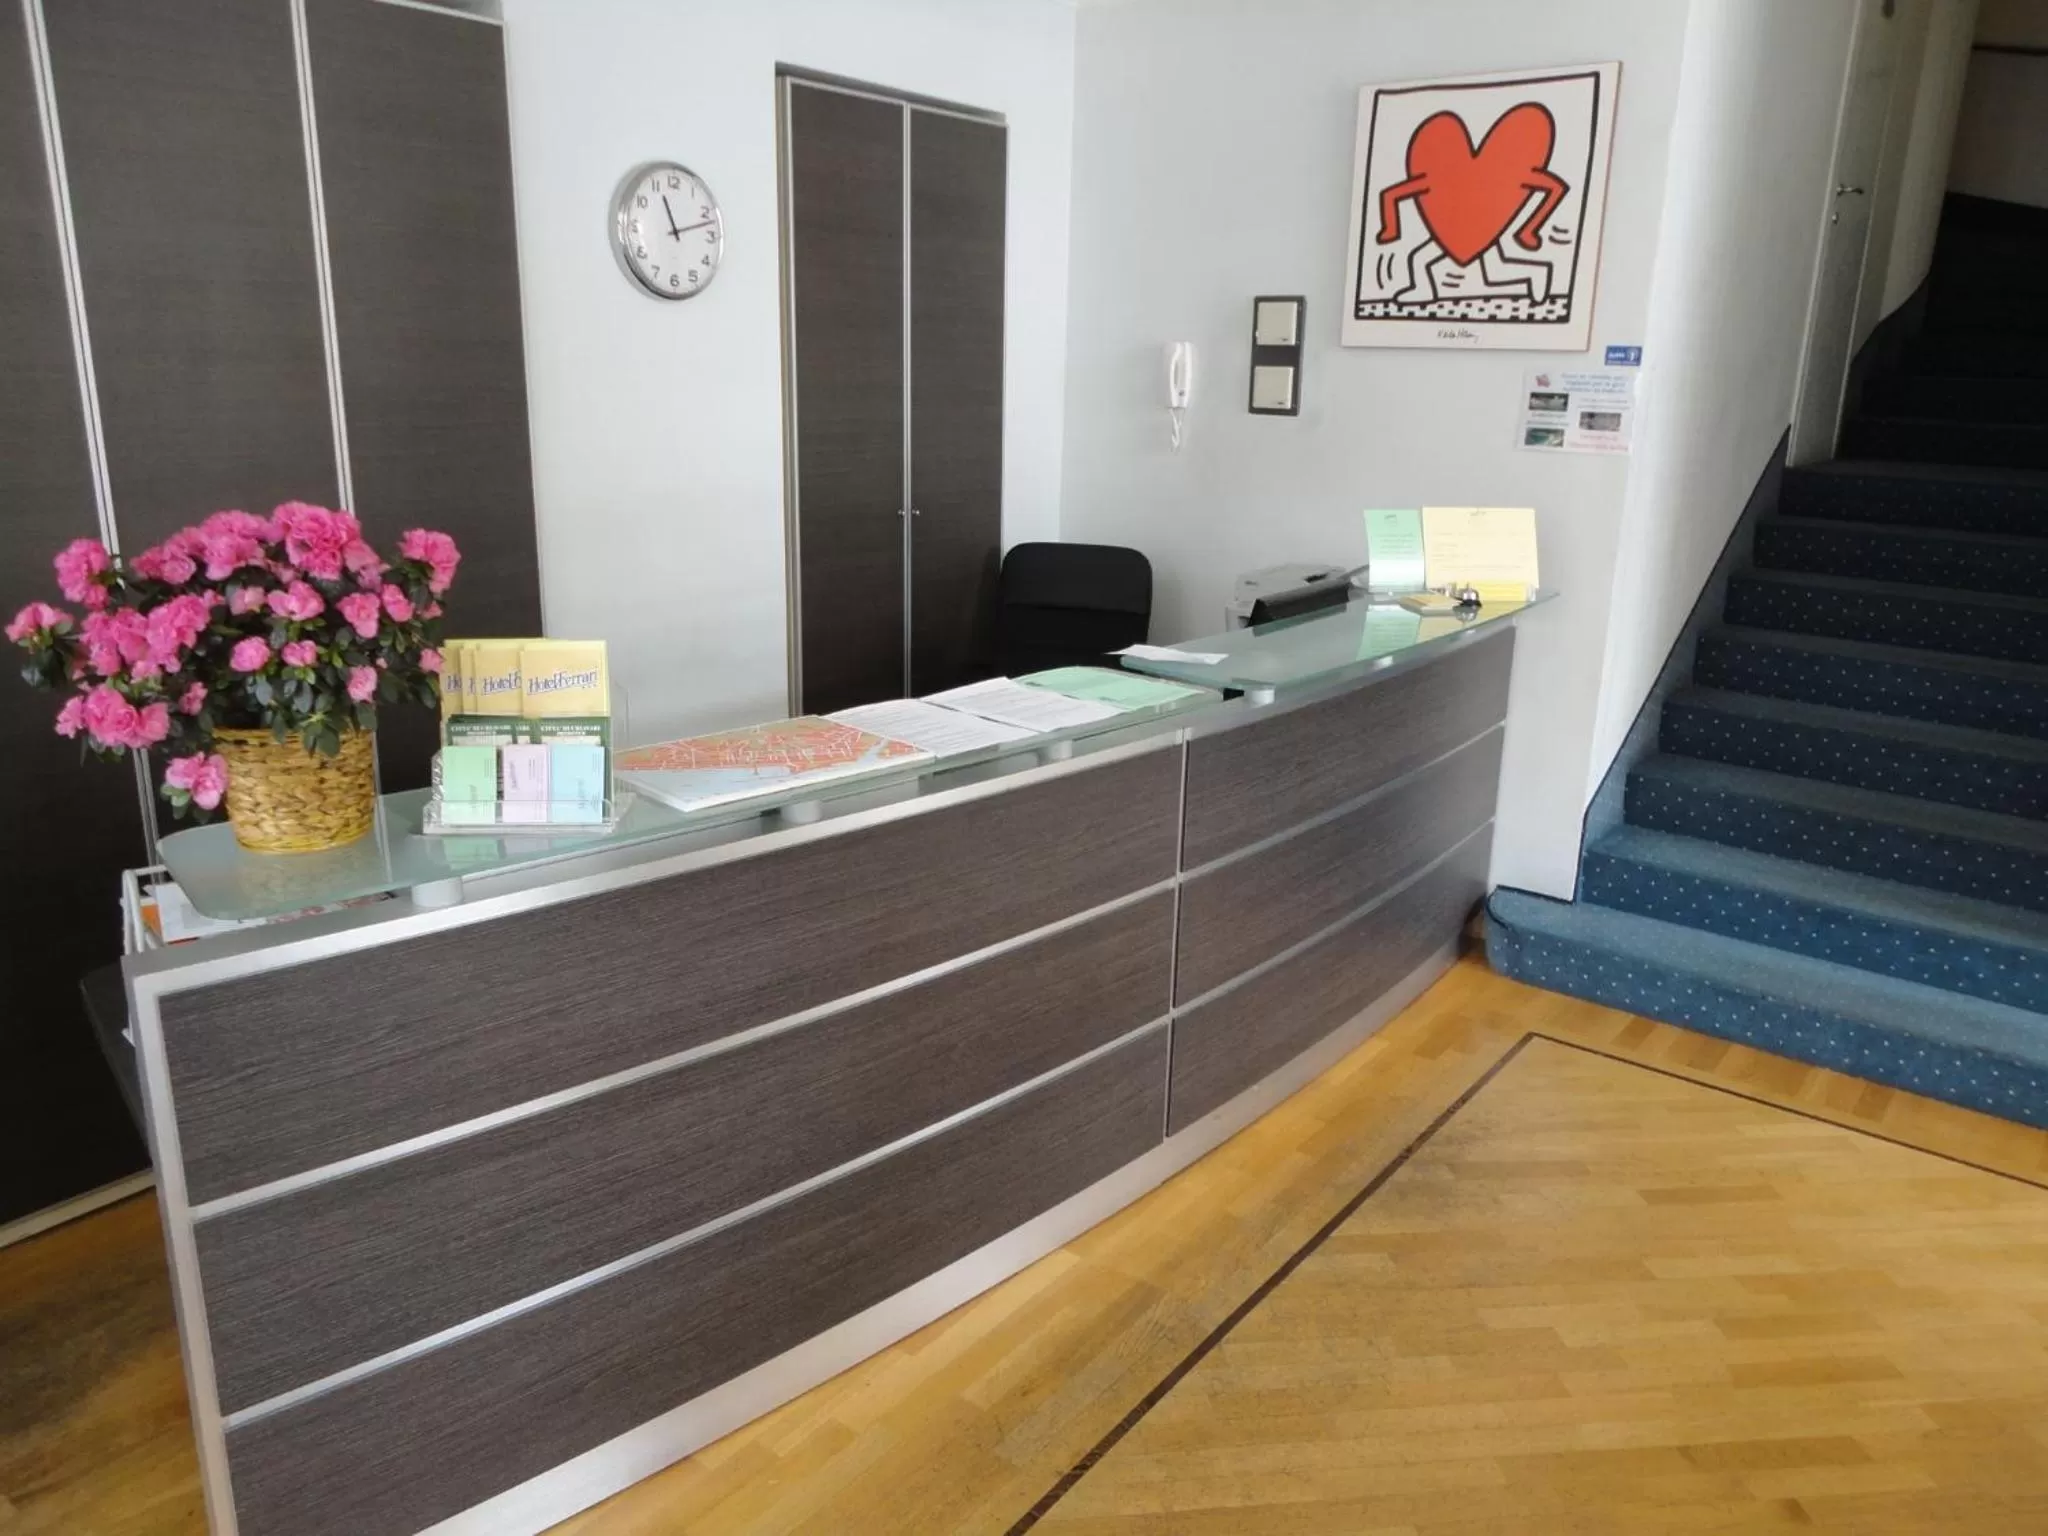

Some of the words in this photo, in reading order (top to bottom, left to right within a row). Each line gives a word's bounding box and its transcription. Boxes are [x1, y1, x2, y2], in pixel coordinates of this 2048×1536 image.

[651, 179, 660, 192] 11
[667, 175, 680, 189] 12
[636, 195, 648, 208] 10
[699, 206, 710, 219] 2
[706, 231, 716, 244] 3
[636, 246, 648, 260] 8
[701, 255, 711, 266] 4
[651, 265, 660, 279] 7
[688, 269, 699, 282] 5
[669, 274, 680, 287] 6
